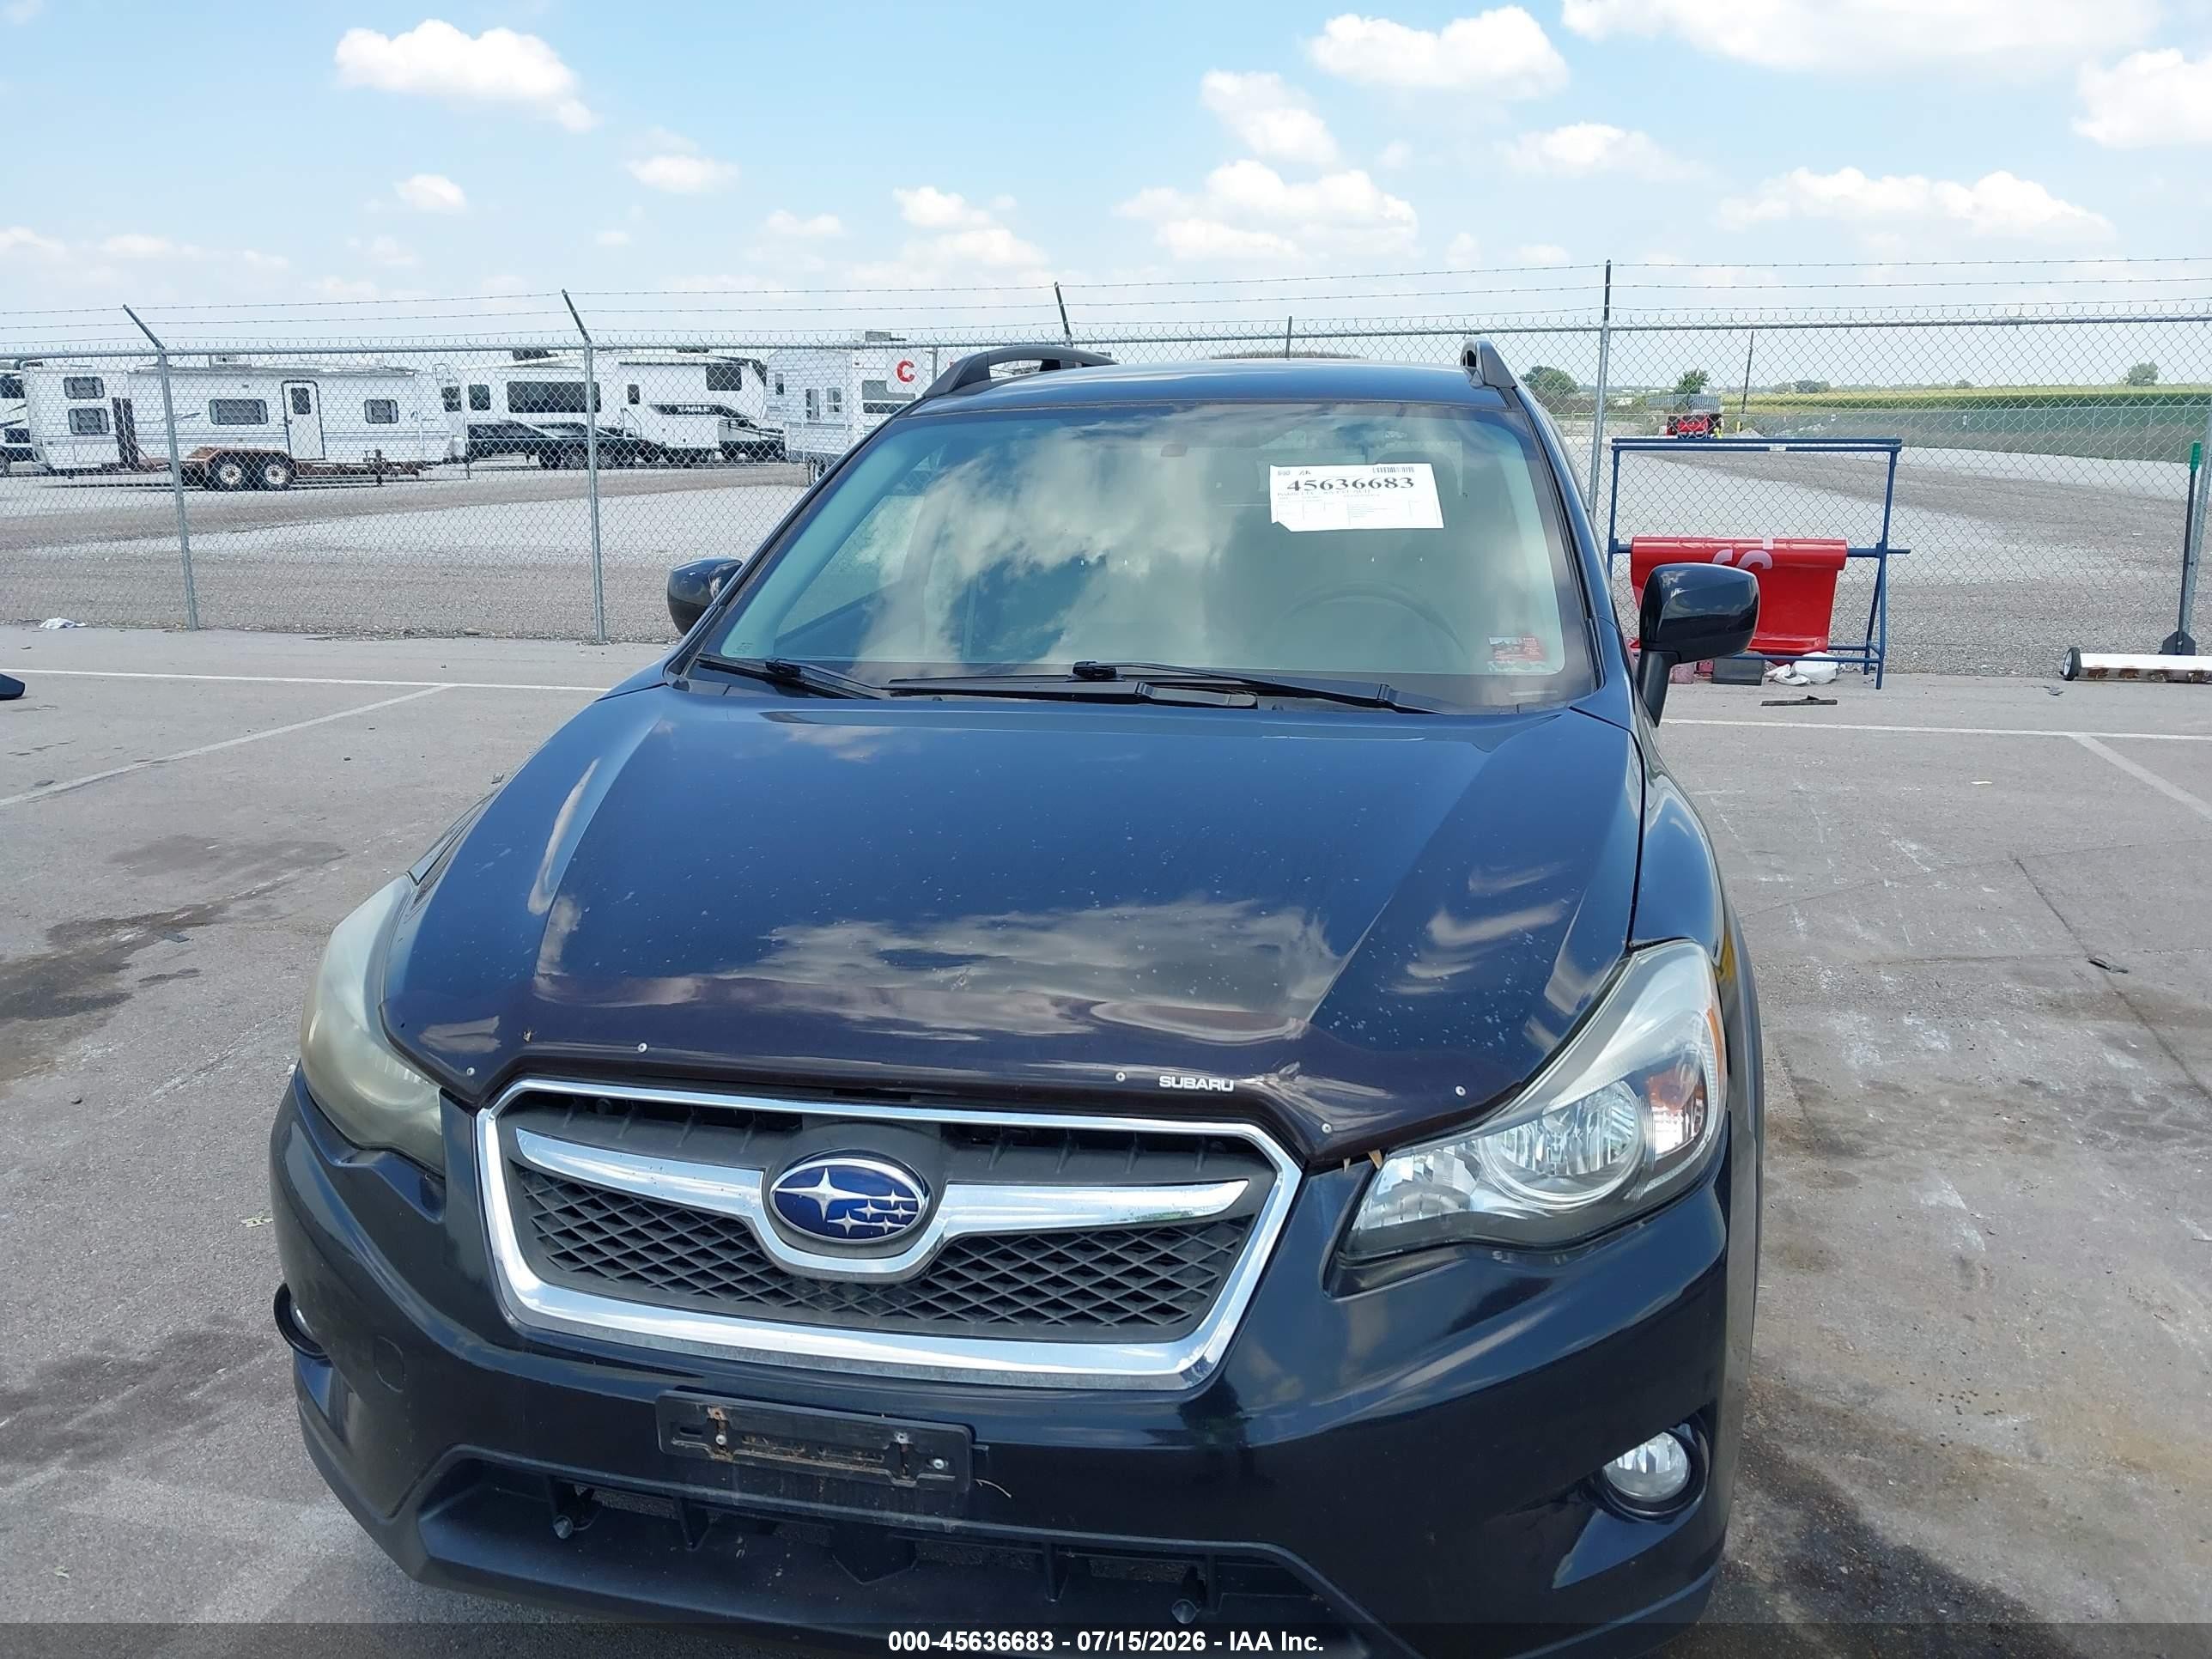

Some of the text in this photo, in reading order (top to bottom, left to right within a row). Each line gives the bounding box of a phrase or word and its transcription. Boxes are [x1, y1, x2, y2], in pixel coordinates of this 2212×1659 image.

[896, 360, 915, 383] C
[1286, 477, 1415, 492] 45636683
[1158, 1075, 1235, 1092] SUBARU
